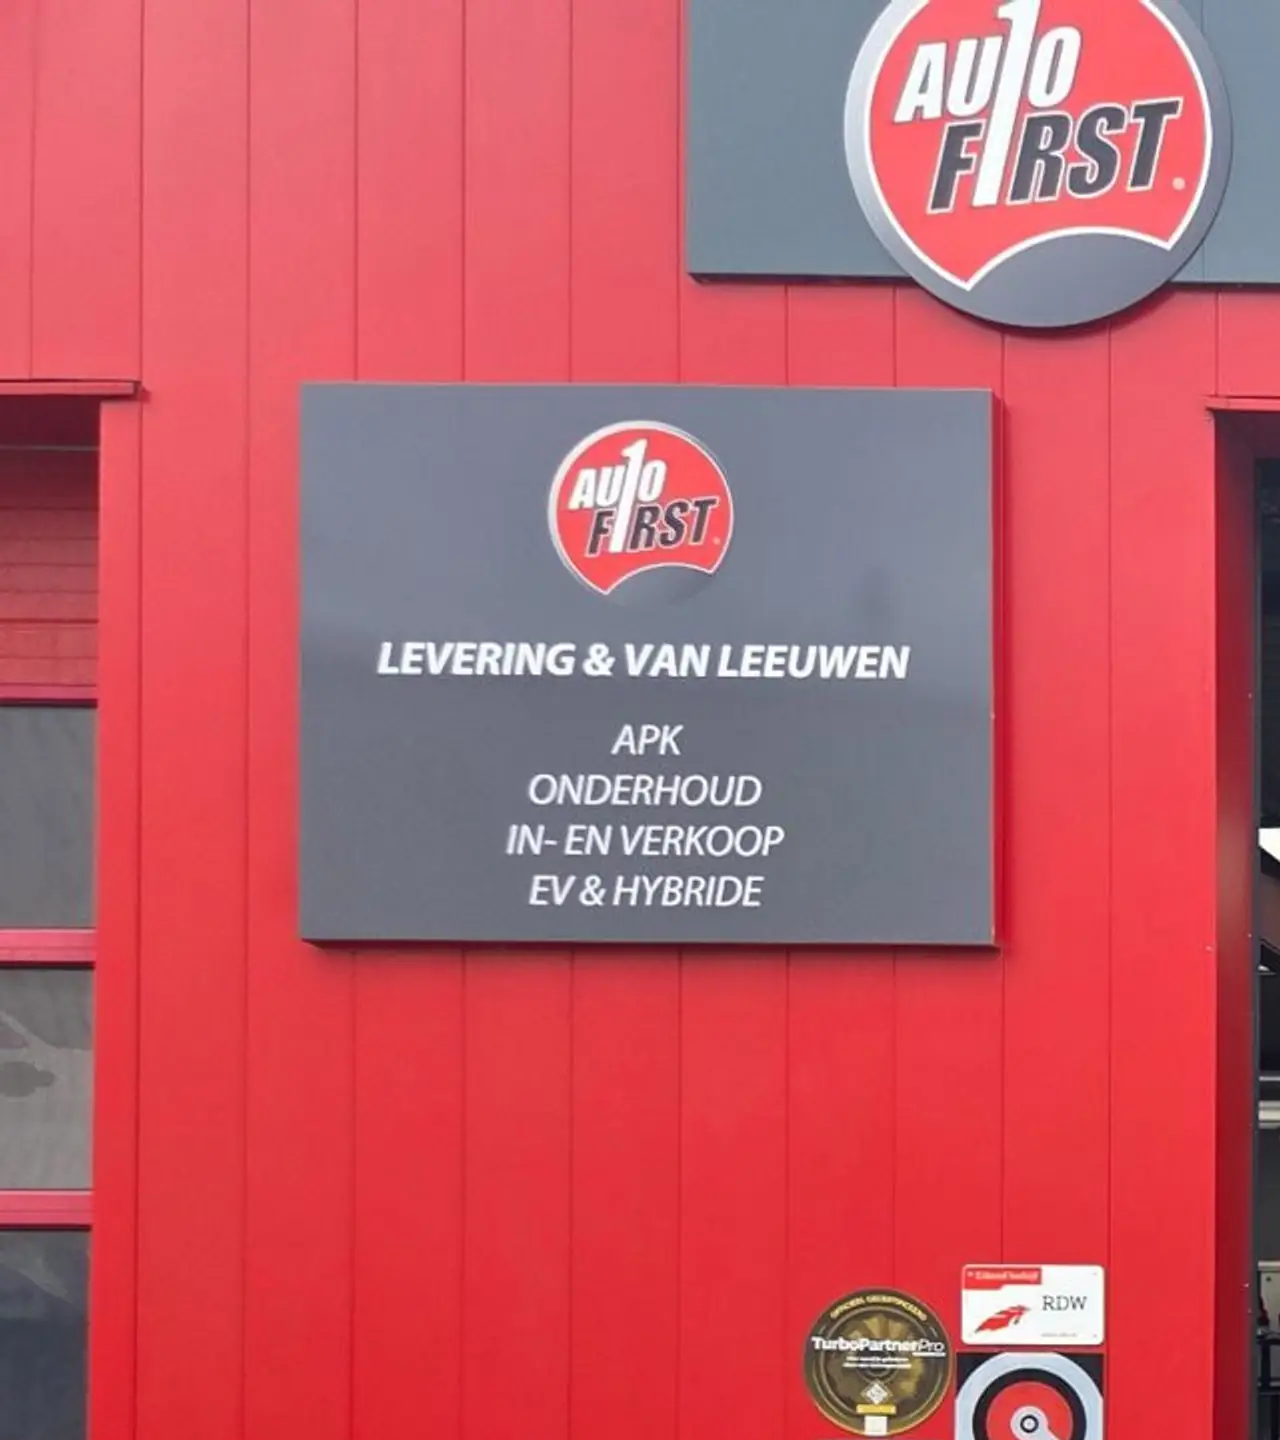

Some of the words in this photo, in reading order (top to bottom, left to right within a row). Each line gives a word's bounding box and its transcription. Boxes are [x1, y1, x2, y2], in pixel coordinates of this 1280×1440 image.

[926, 96, 1183, 214] FIRST
[584, 496, 719, 556] FIRST
[377, 642, 576, 676] LEVERING
[582, 643, 613, 677] &
[623, 644, 711, 677] VAN
[717, 644, 911, 679] LEEUWEN
[612, 725, 683, 755] APK
[528, 774, 762, 806] ONDERHOUD
[506, 825, 558, 856] IN-
[564, 826, 611, 856] EN
[622, 825, 785, 856] VERKOOP
[529, 876, 577, 906] EV
[578, 876, 606, 906] &
[613, 876, 764, 907] HYBRIDE
[1042, 1295, 1088, 1311] RDW
[811, 1336, 946, 1354] TurboPartnerPro
